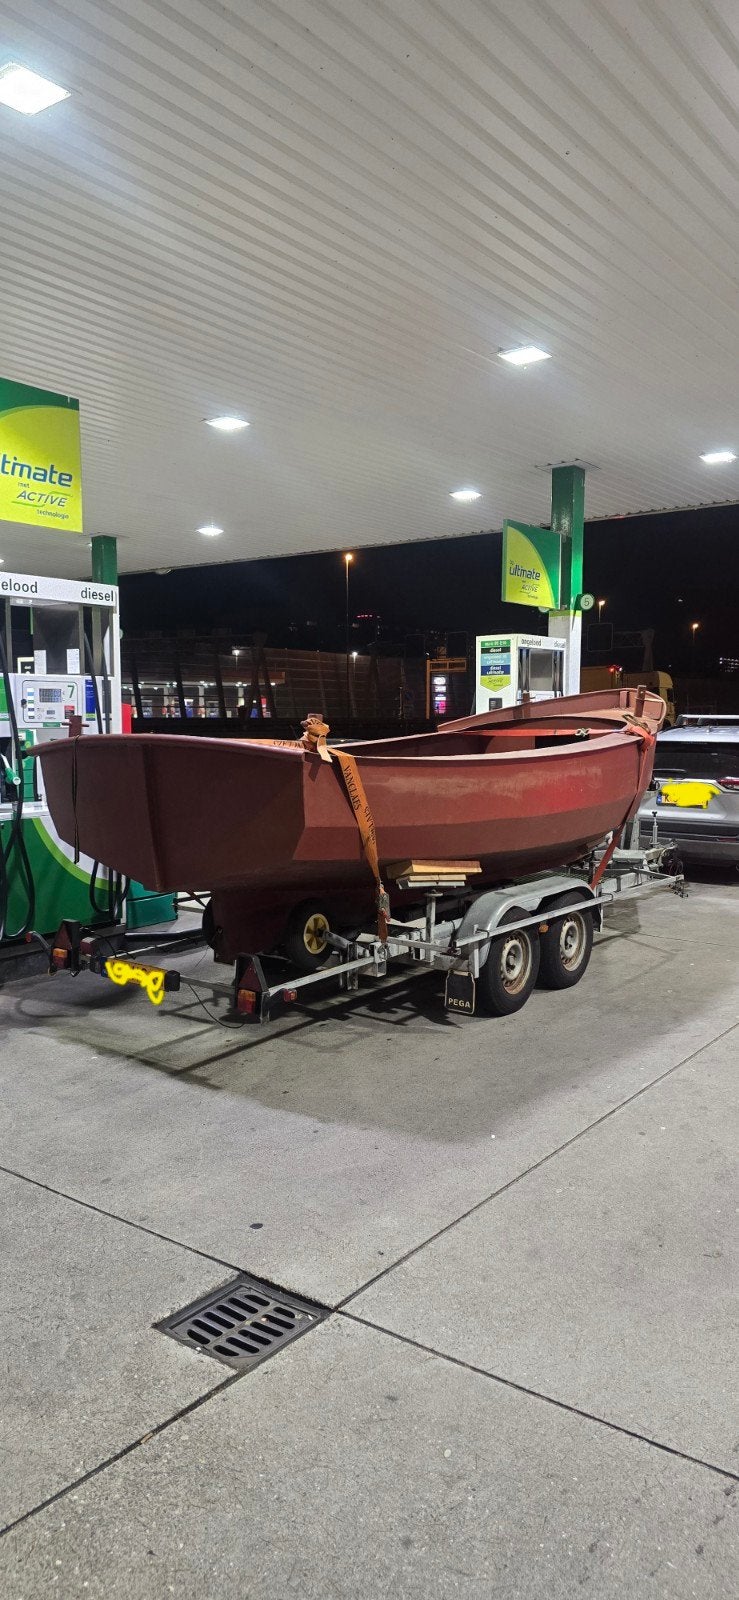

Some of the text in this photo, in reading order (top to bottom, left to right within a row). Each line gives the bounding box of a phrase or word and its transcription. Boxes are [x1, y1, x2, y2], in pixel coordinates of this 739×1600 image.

[17, 490, 67, 507] ACTIVE
[509, 564, 540, 580] ultimate
[80, 587, 114, 602] diesel
[584, 597, 590, 606] 5
[67, 685, 75, 698] 7
[448, 998, 471, 1008] PEGA
